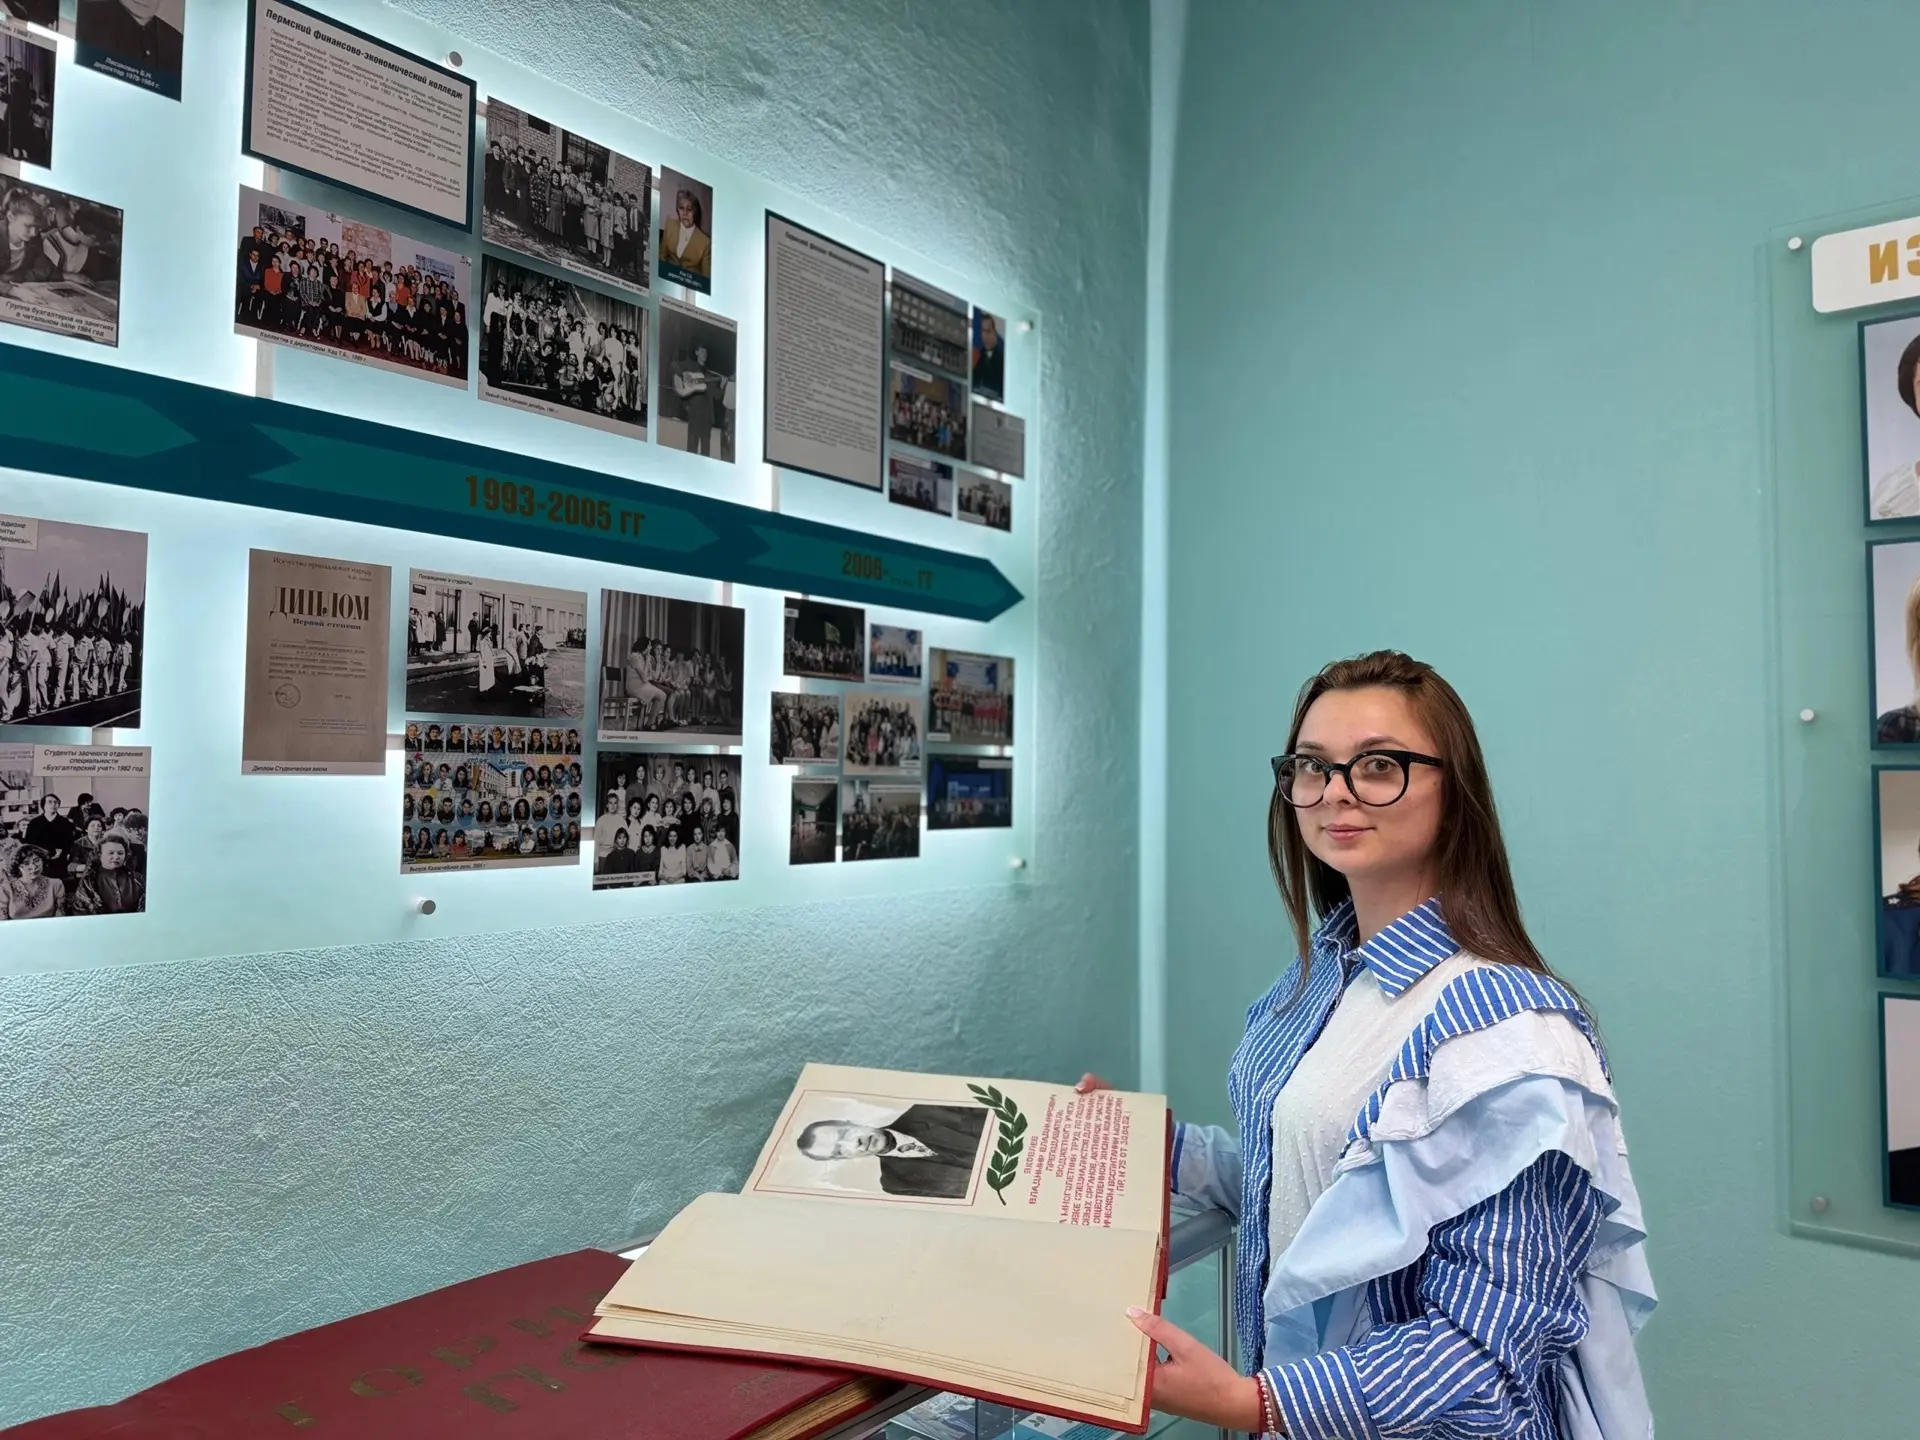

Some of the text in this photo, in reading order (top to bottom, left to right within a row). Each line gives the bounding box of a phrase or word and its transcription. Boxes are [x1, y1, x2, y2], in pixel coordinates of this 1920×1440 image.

[265, 8, 462, 101] Пермский финансово-экономический колледж
[6, 301, 30, 312] Группа
[32, 307, 74, 322] бухгалтеров
[84, 321, 114, 332] занятиях
[22, 314, 58, 326] читальном
[60, 322, 76, 330] зале
[92, 329, 104, 338] год
[259, 332, 289, 344] Коллектив
[294, 341, 326, 354] директором
[466, 474, 612, 531] 1993-2005
[269, 586, 370, 621] ДИПЛОМ
[292, 618, 361, 630] Первой степени
[42, 764, 96, 772] «Бухгалтерский
[44, 749, 143, 758] Студенты заочного отделения
[252, 764, 274, 772] Диплом
[1074, 1119, 1081, 1129] ПО
[1095, 1094, 1105, 1121] УЧАСТИЕ
[1111, 1097, 1123, 1135] МОЛОДЕЖИ
[1024, 1135, 1038, 1174] ЯКОВЛЕВ
[1028, 1093, 1056, 1204] ВЛАДИМИР ВЛАДИМИРОВИЧ
[1045, 1109, 1063, 1171] ПРЕПОДАВАТЕЛЬ
[1055, 1101, 1074, 1177] БЮДЖЕТНОГО УЧЕТА
[1070, 1130, 1081, 1151] ТРУД
[1089, 1123, 1102, 1160] АКТИВНОЕ
[1119, 1147, 1127, 1157] ОТ
[1073, 1139, 1090, 1200] СПЕЦИАЛИСТОВ
[1082, 1121, 1092, 1138] ДЛЯ
[1106, 1137, 1121, 1185] ВОСПИТАНИИ
[1059, 1153, 1077, 1215] МНОГОЛЕТНИЙ
